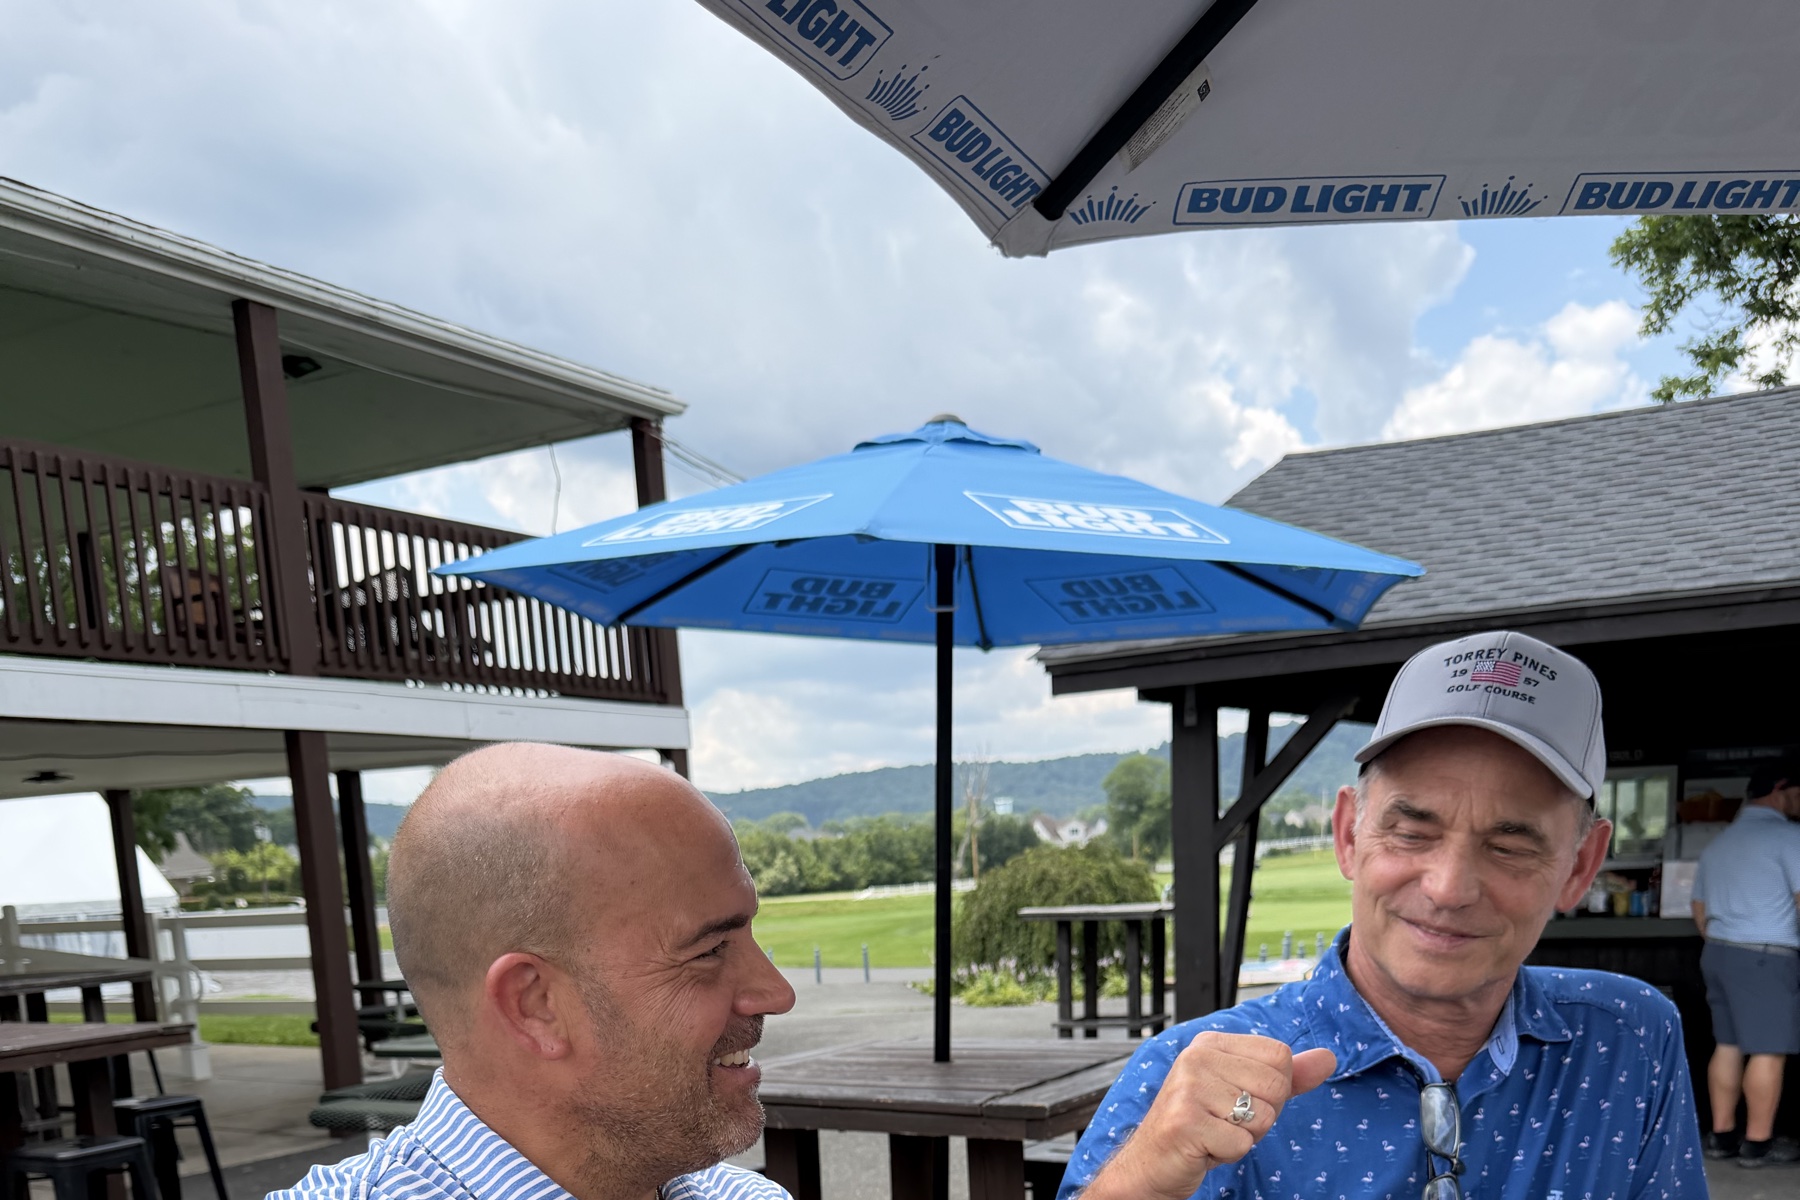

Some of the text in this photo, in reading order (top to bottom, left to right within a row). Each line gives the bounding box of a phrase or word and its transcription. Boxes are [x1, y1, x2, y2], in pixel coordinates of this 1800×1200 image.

[928, 107, 1042, 209] BUD LIGHT
[1187, 183, 1431, 214] BUD LIGHT
[1573, 179, 1800, 210] BUD LIGHT
[1002, 510, 1202, 538] LIGHT
[1009, 499, 1154, 523] BUD
[1443, 648, 1558, 682] TORREY PINES
[1450, 668, 1541, 688] 19 57
[1446, 684, 1537, 705] GOLF COURSE
